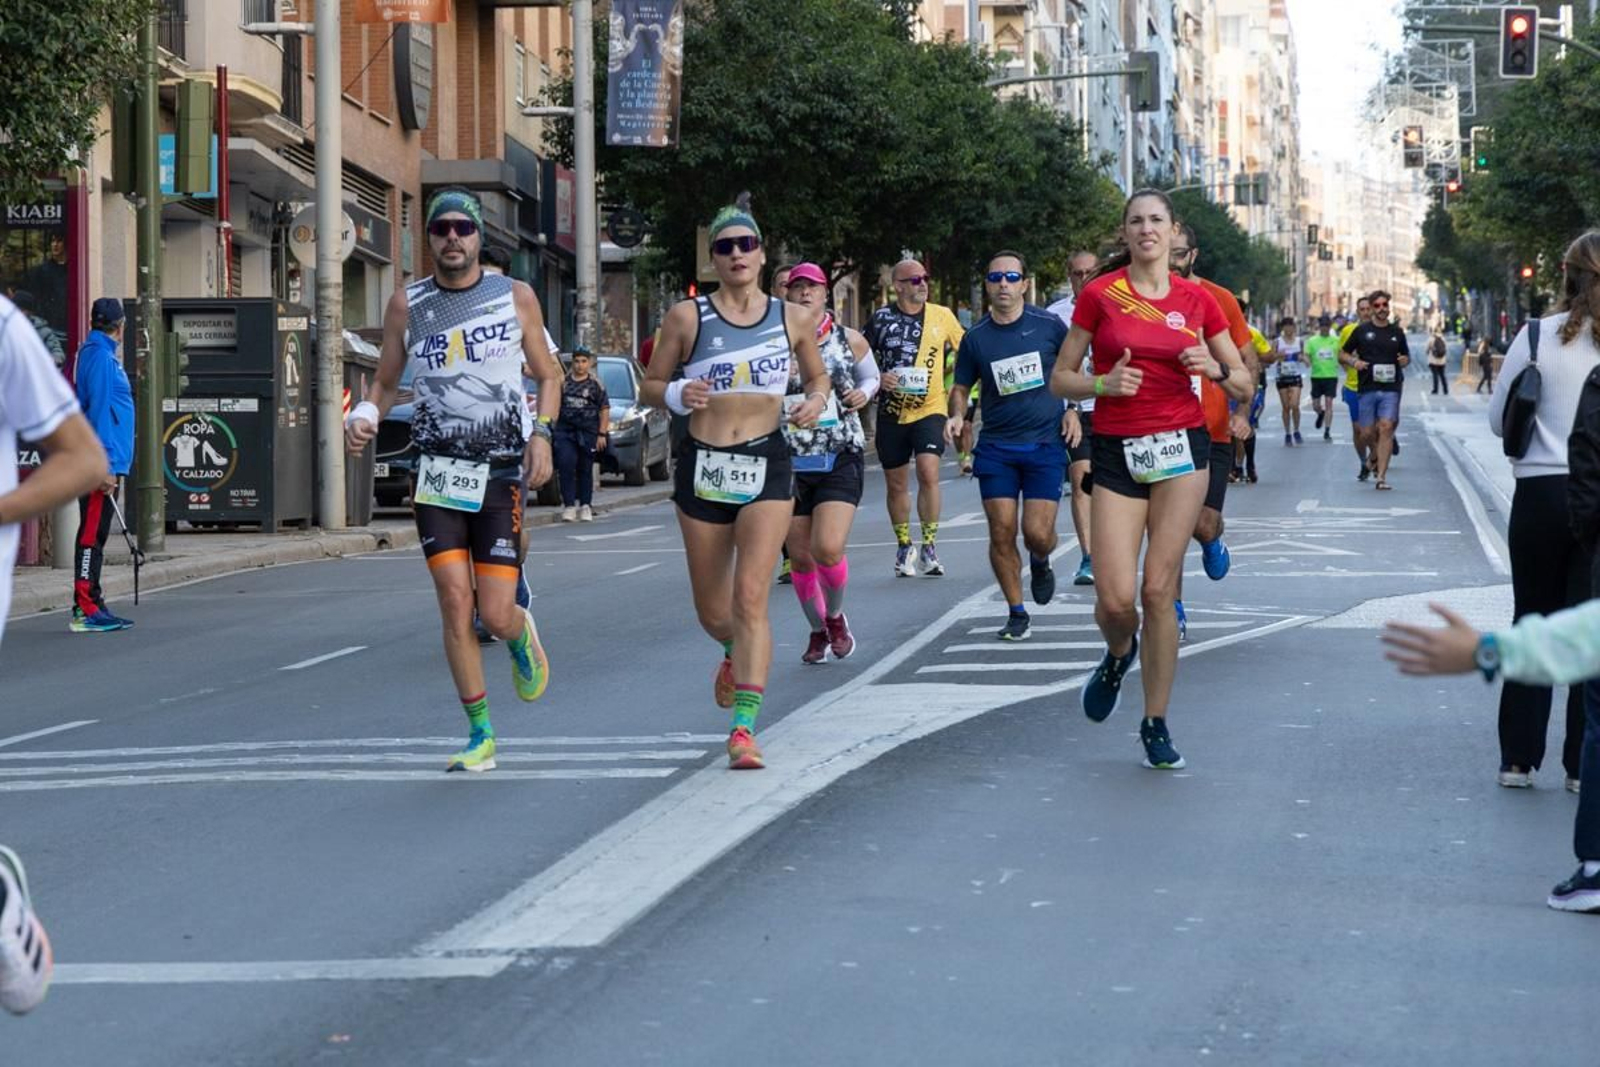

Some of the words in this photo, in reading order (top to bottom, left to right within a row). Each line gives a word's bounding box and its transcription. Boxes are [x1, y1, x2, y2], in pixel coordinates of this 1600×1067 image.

[641, 59, 652, 69] El
[619, 80, 631, 88] de
[633, 80, 642, 88] la
[626, 90, 636, 98] la
[7, 204, 62, 219] KIABI
[182, 320, 221, 329] DEPOSITAR
[223, 321, 233, 329] EN
[1019, 363, 1037, 375] 177
[909, 375, 925, 383] 164
[184, 423, 215, 435] ROPA
[1160, 442, 1185, 458] 400
[19, 450, 42, 465] ZA
[174, 470, 182, 478] Y
[183, 470, 224, 479] CALZADO
[729, 469, 757, 484] 511
[452, 475, 480, 490] 293
[230, 489, 241, 497] NO
